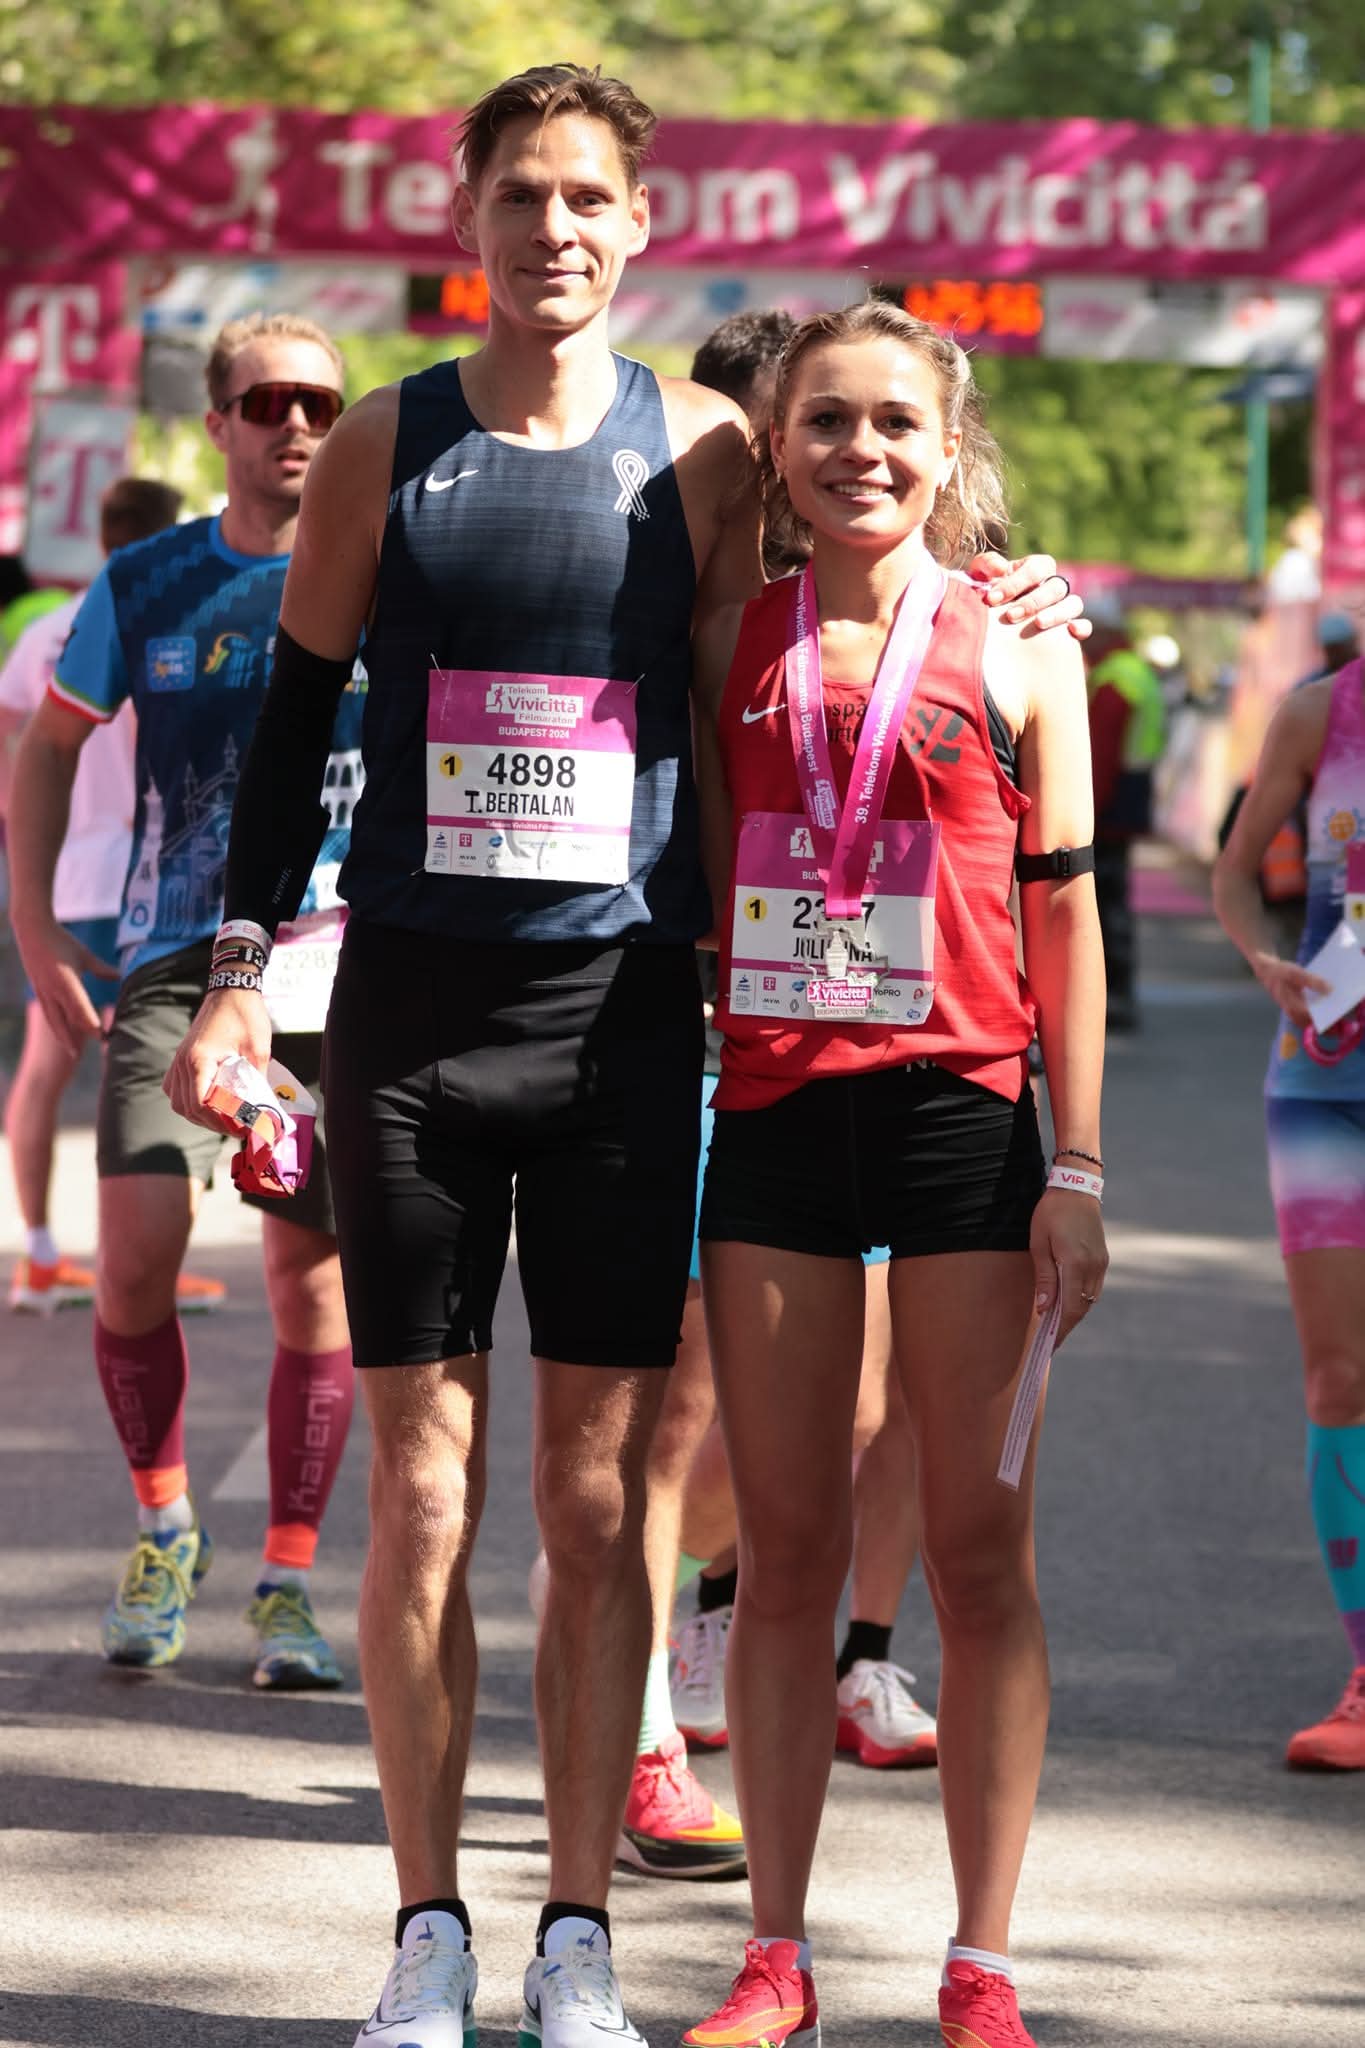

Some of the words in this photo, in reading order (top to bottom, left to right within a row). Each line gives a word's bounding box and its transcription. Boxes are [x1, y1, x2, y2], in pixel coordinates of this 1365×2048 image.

[508, 686, 546, 695] Telekom
[508, 696, 577, 713] Vivicittá
[498, 726, 547, 738] BUDAPEST
[801, 714, 819, 773] Budapest
[444, 755, 456, 777] 1
[486, 752, 577, 789] 4898
[859, 748, 882, 801] Telekom
[855, 804, 870, 824] 39.
[749, 899, 760, 919] 1
[1061, 1172, 1085, 1185] VIP
[288, 1378, 344, 1513] Kalenji
